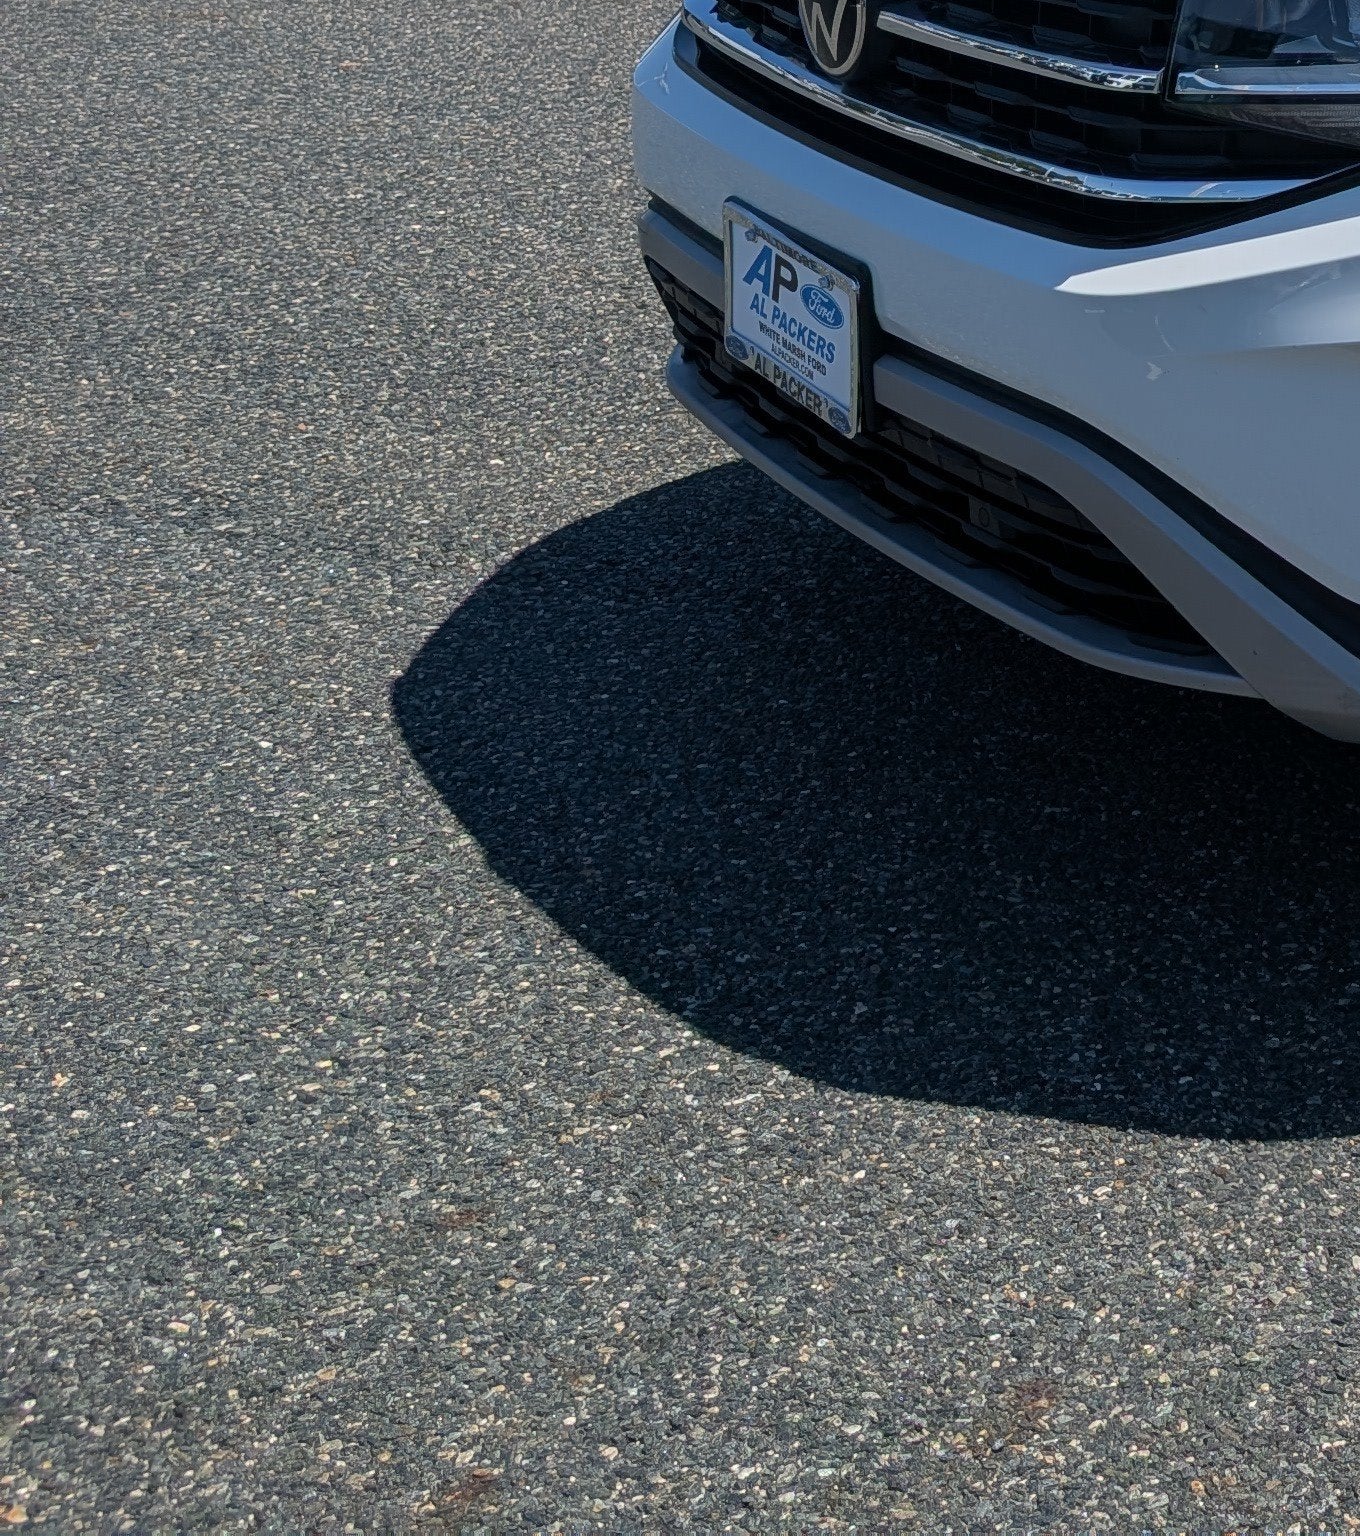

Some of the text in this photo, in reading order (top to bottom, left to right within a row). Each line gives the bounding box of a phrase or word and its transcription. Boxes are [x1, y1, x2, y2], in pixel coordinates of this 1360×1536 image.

[742, 244, 799, 304] AP
[749, 292, 768, 320] AL
[771, 304, 836, 364] PACKERS
[758, 320, 827, 377] WHITE MARSH FORD
